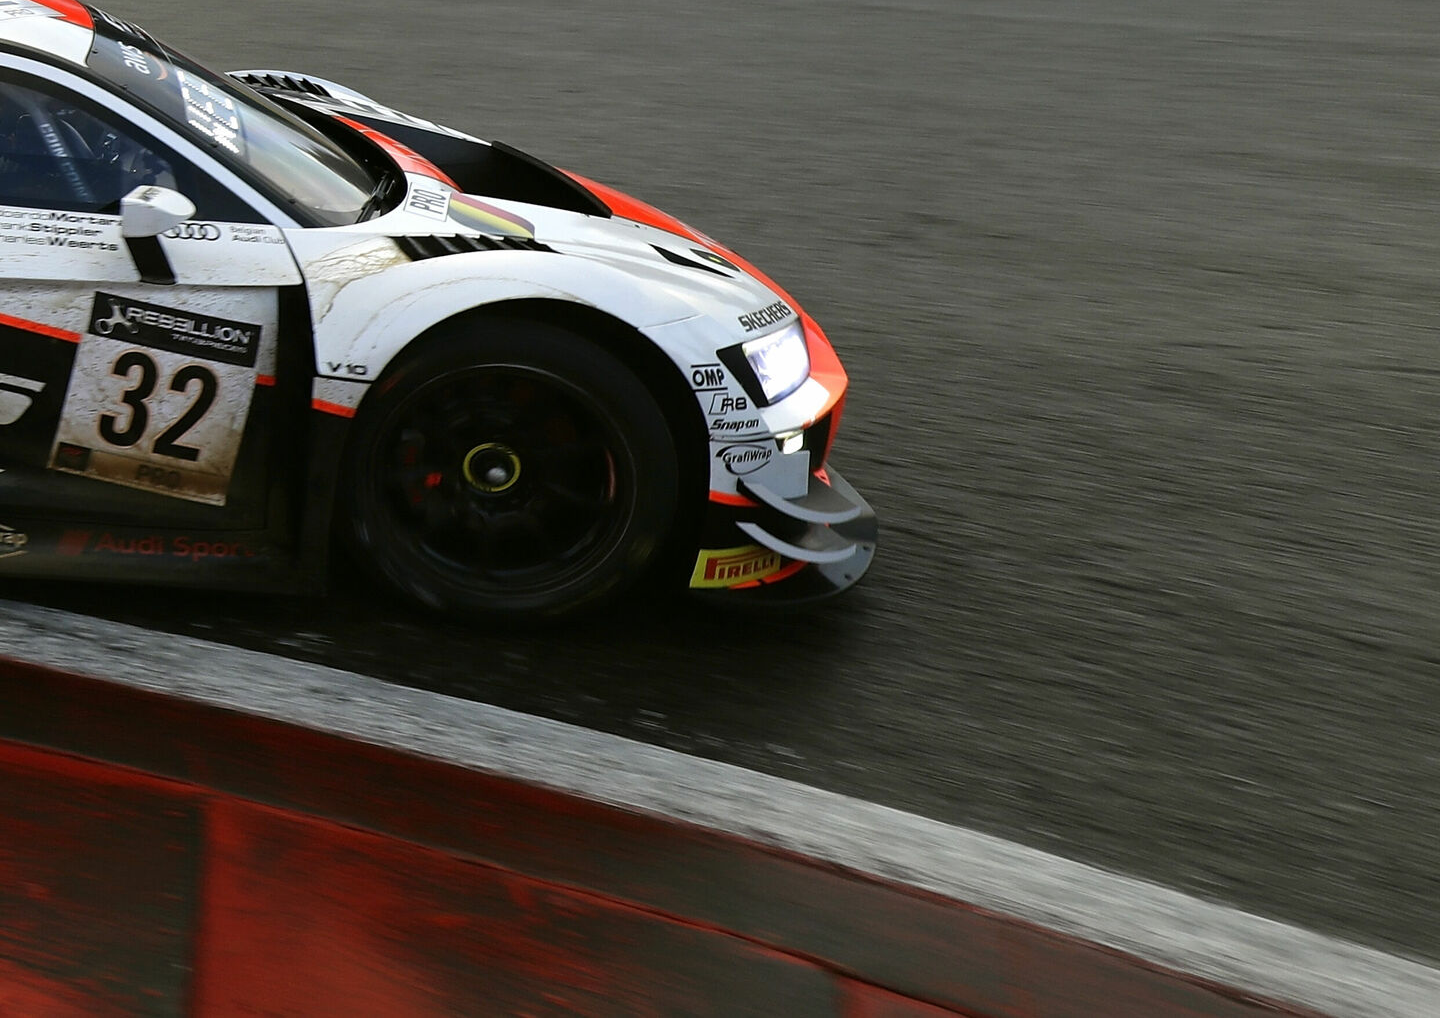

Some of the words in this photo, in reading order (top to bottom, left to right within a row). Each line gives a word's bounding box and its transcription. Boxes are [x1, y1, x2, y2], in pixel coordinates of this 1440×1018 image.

[410, 188, 447, 215] PRO
[126, 307, 251, 344] REBELLION
[738, 300, 791, 332] SKECHERS
[692, 368, 725, 386] OMP
[98, 350, 218, 462] 32
[720, 397, 748, 412] R8
[722, 449, 772, 465] GrafiWrap
[94, 533, 164, 555] Audi
[704, 551, 779, 580] PIRELLI
